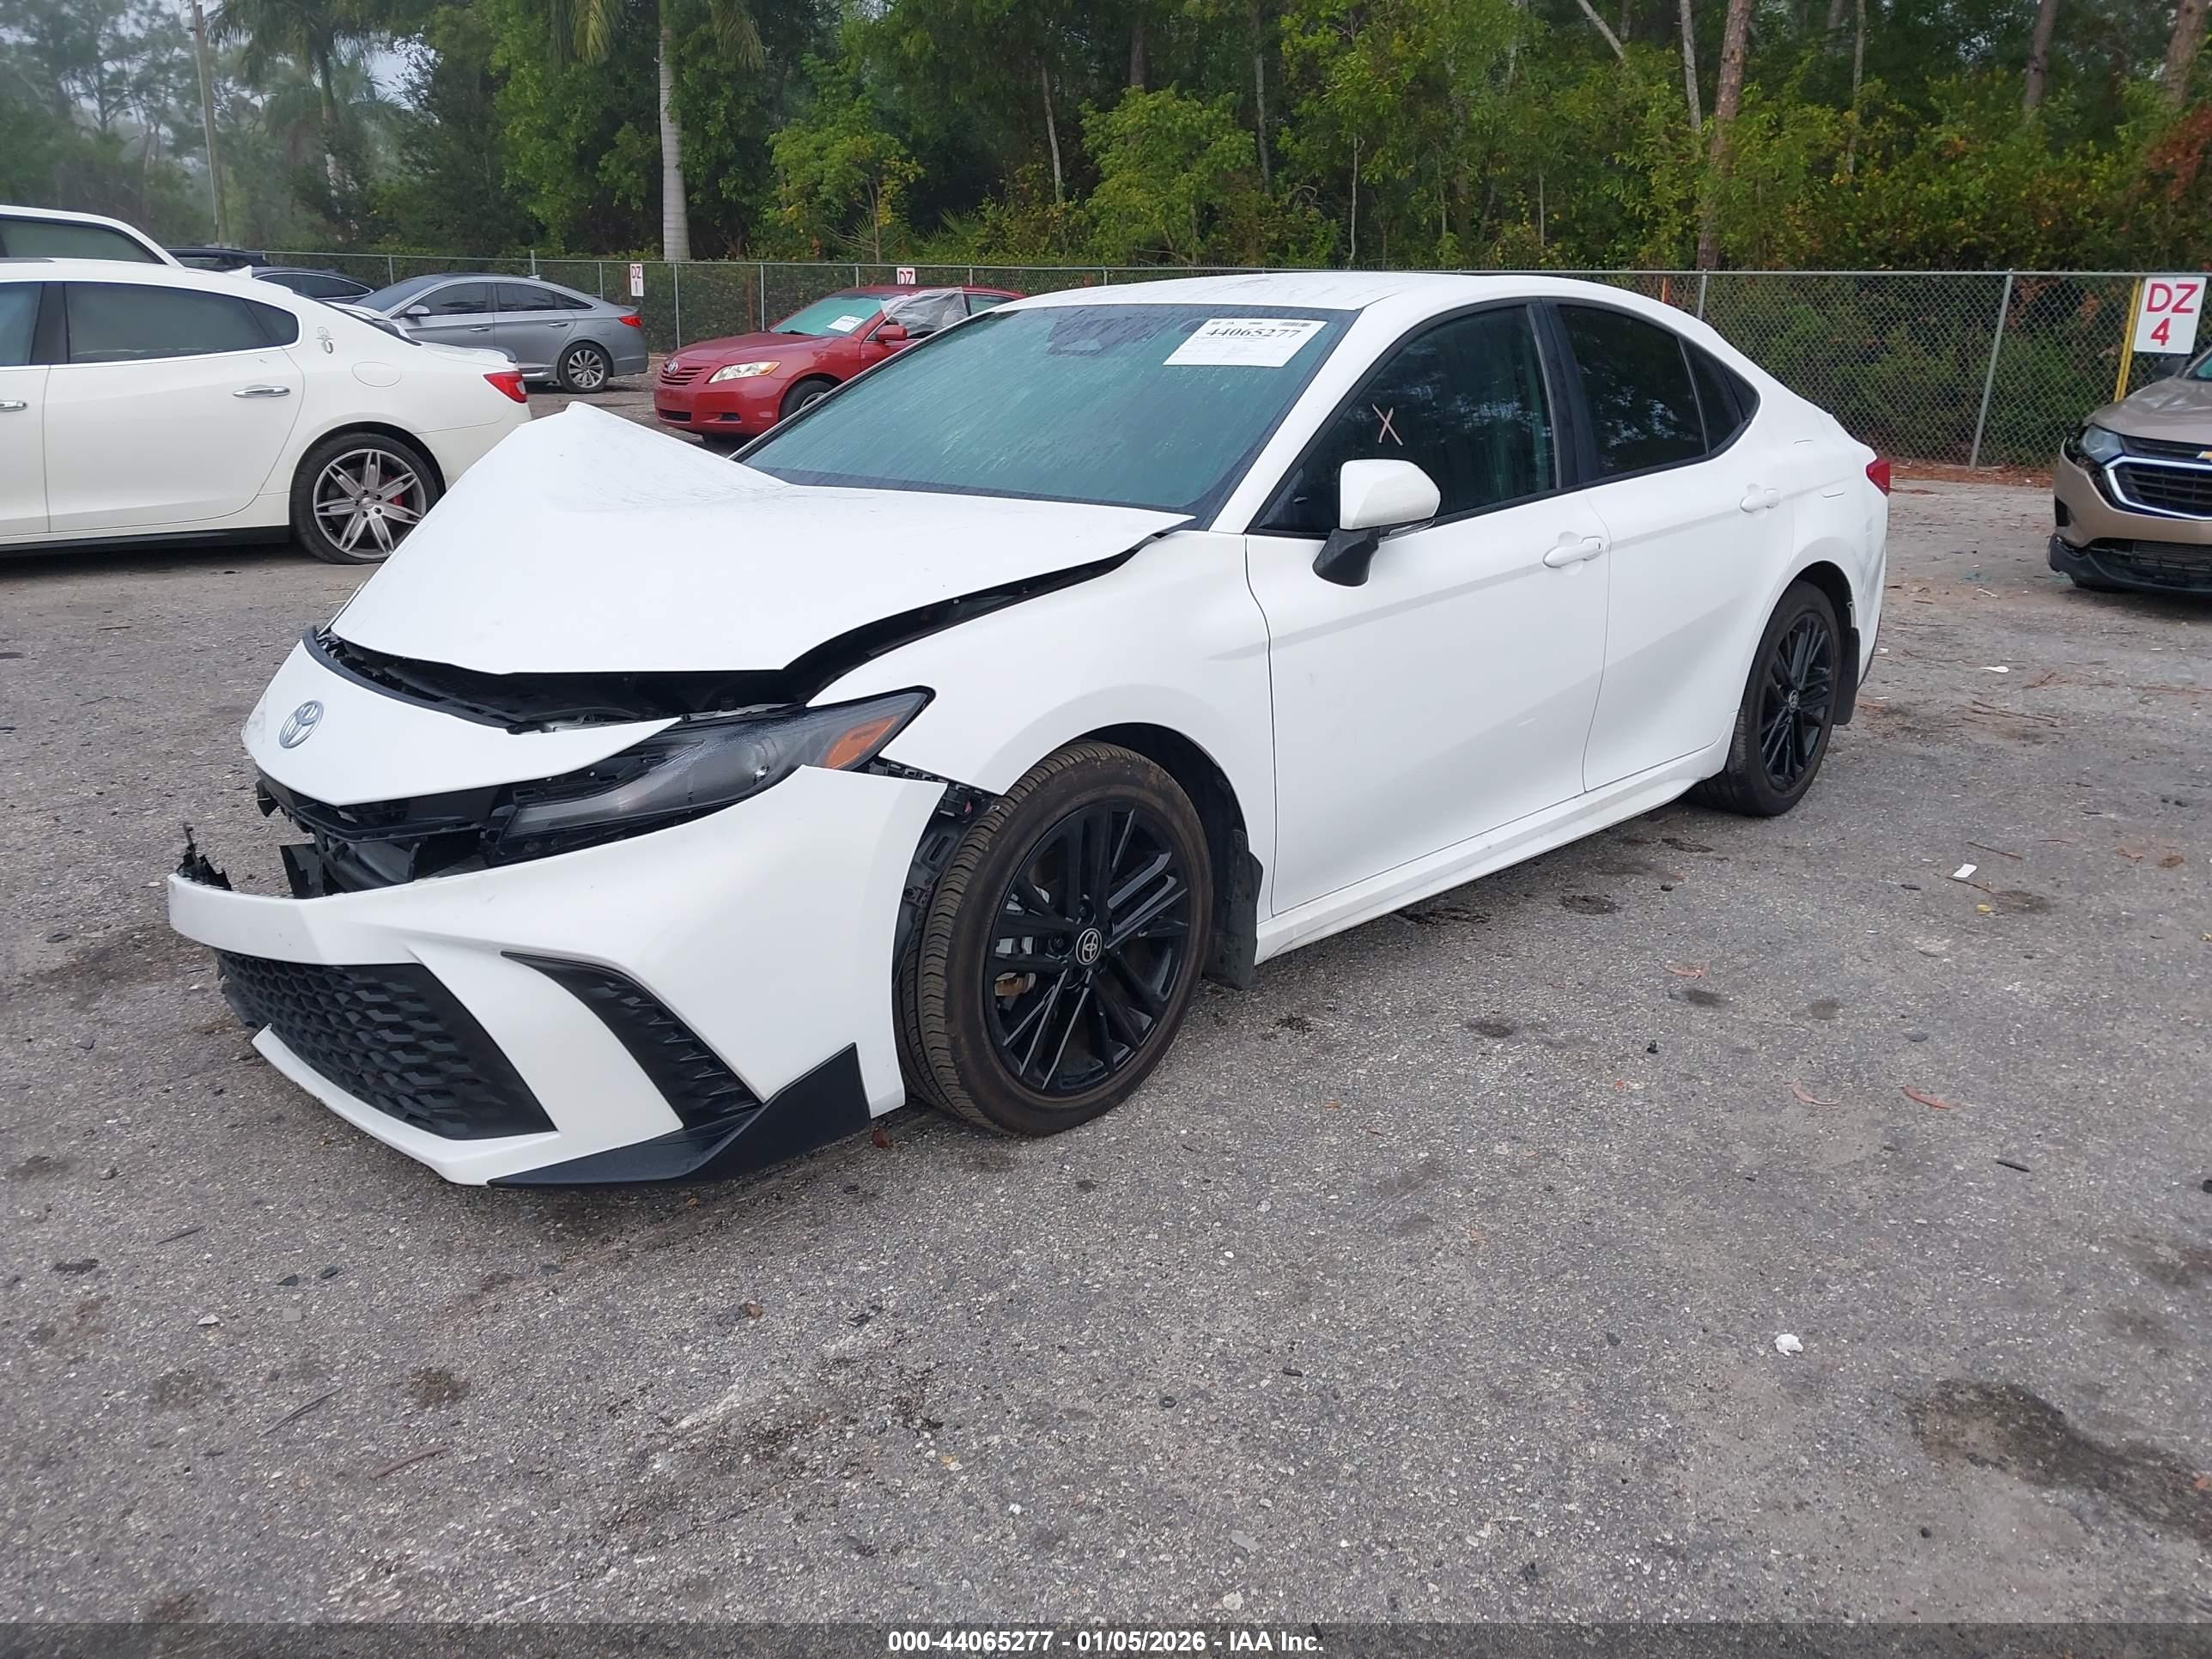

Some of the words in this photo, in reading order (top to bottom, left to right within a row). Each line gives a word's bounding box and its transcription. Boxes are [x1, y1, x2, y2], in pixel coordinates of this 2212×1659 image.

[632, 266, 641, 279] DZ
[2146, 283, 2199, 313] DZ
[1206, 327, 1302, 337] 44065277
[2150, 318, 2171, 346] 4
[1372, 404, 1403, 446] X
